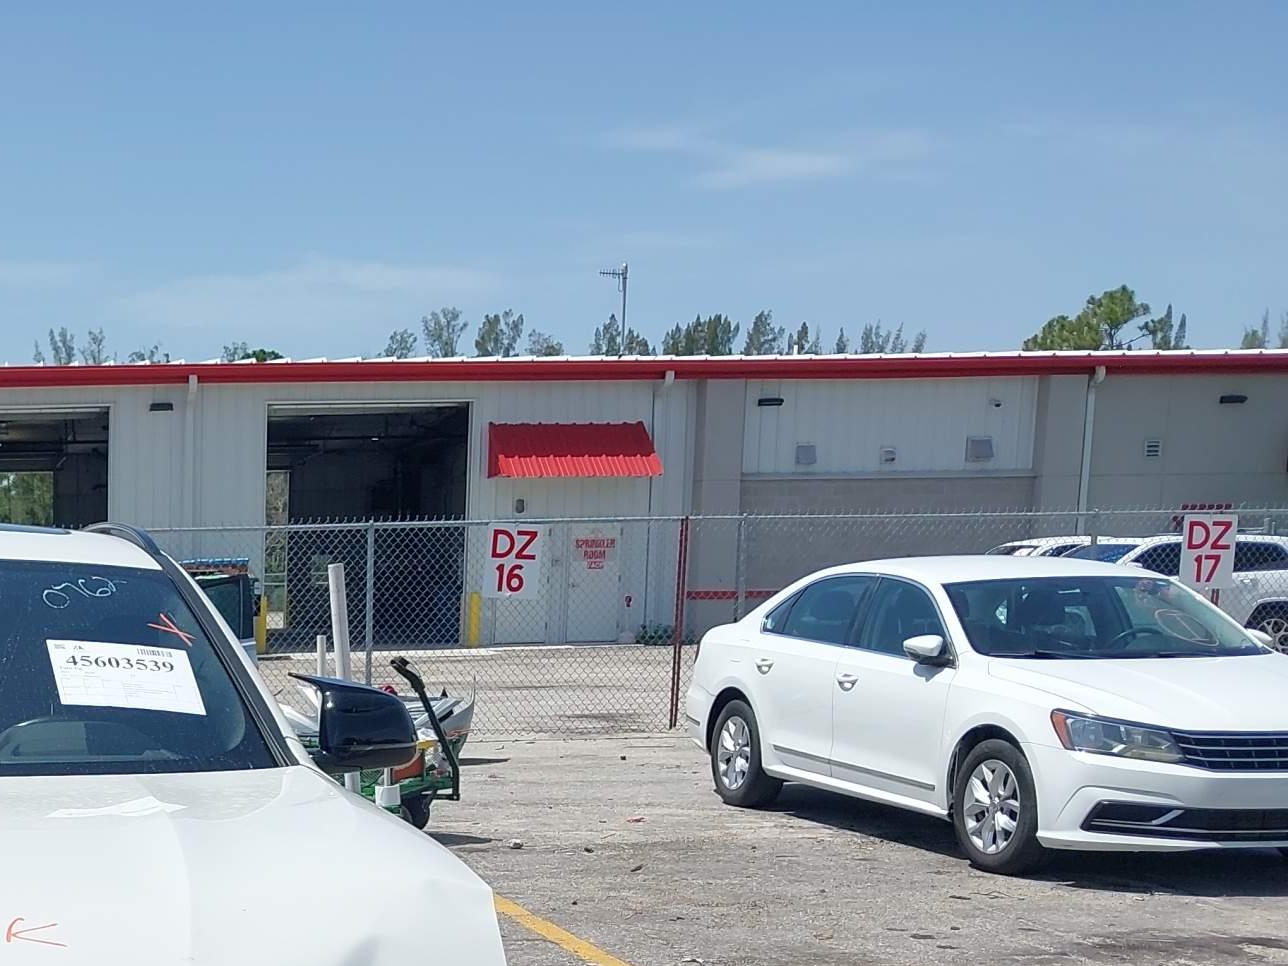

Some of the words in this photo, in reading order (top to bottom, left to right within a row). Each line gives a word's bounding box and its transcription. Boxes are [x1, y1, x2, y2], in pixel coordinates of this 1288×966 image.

[490, 529, 538, 560] DZ
[1187, 520, 1233, 550] DZ
[583, 549, 606, 560] ROOM
[1193, 554, 1221, 583] 17
[495, 563, 524, 592] 16
[66, 655, 175, 673] 45603539
